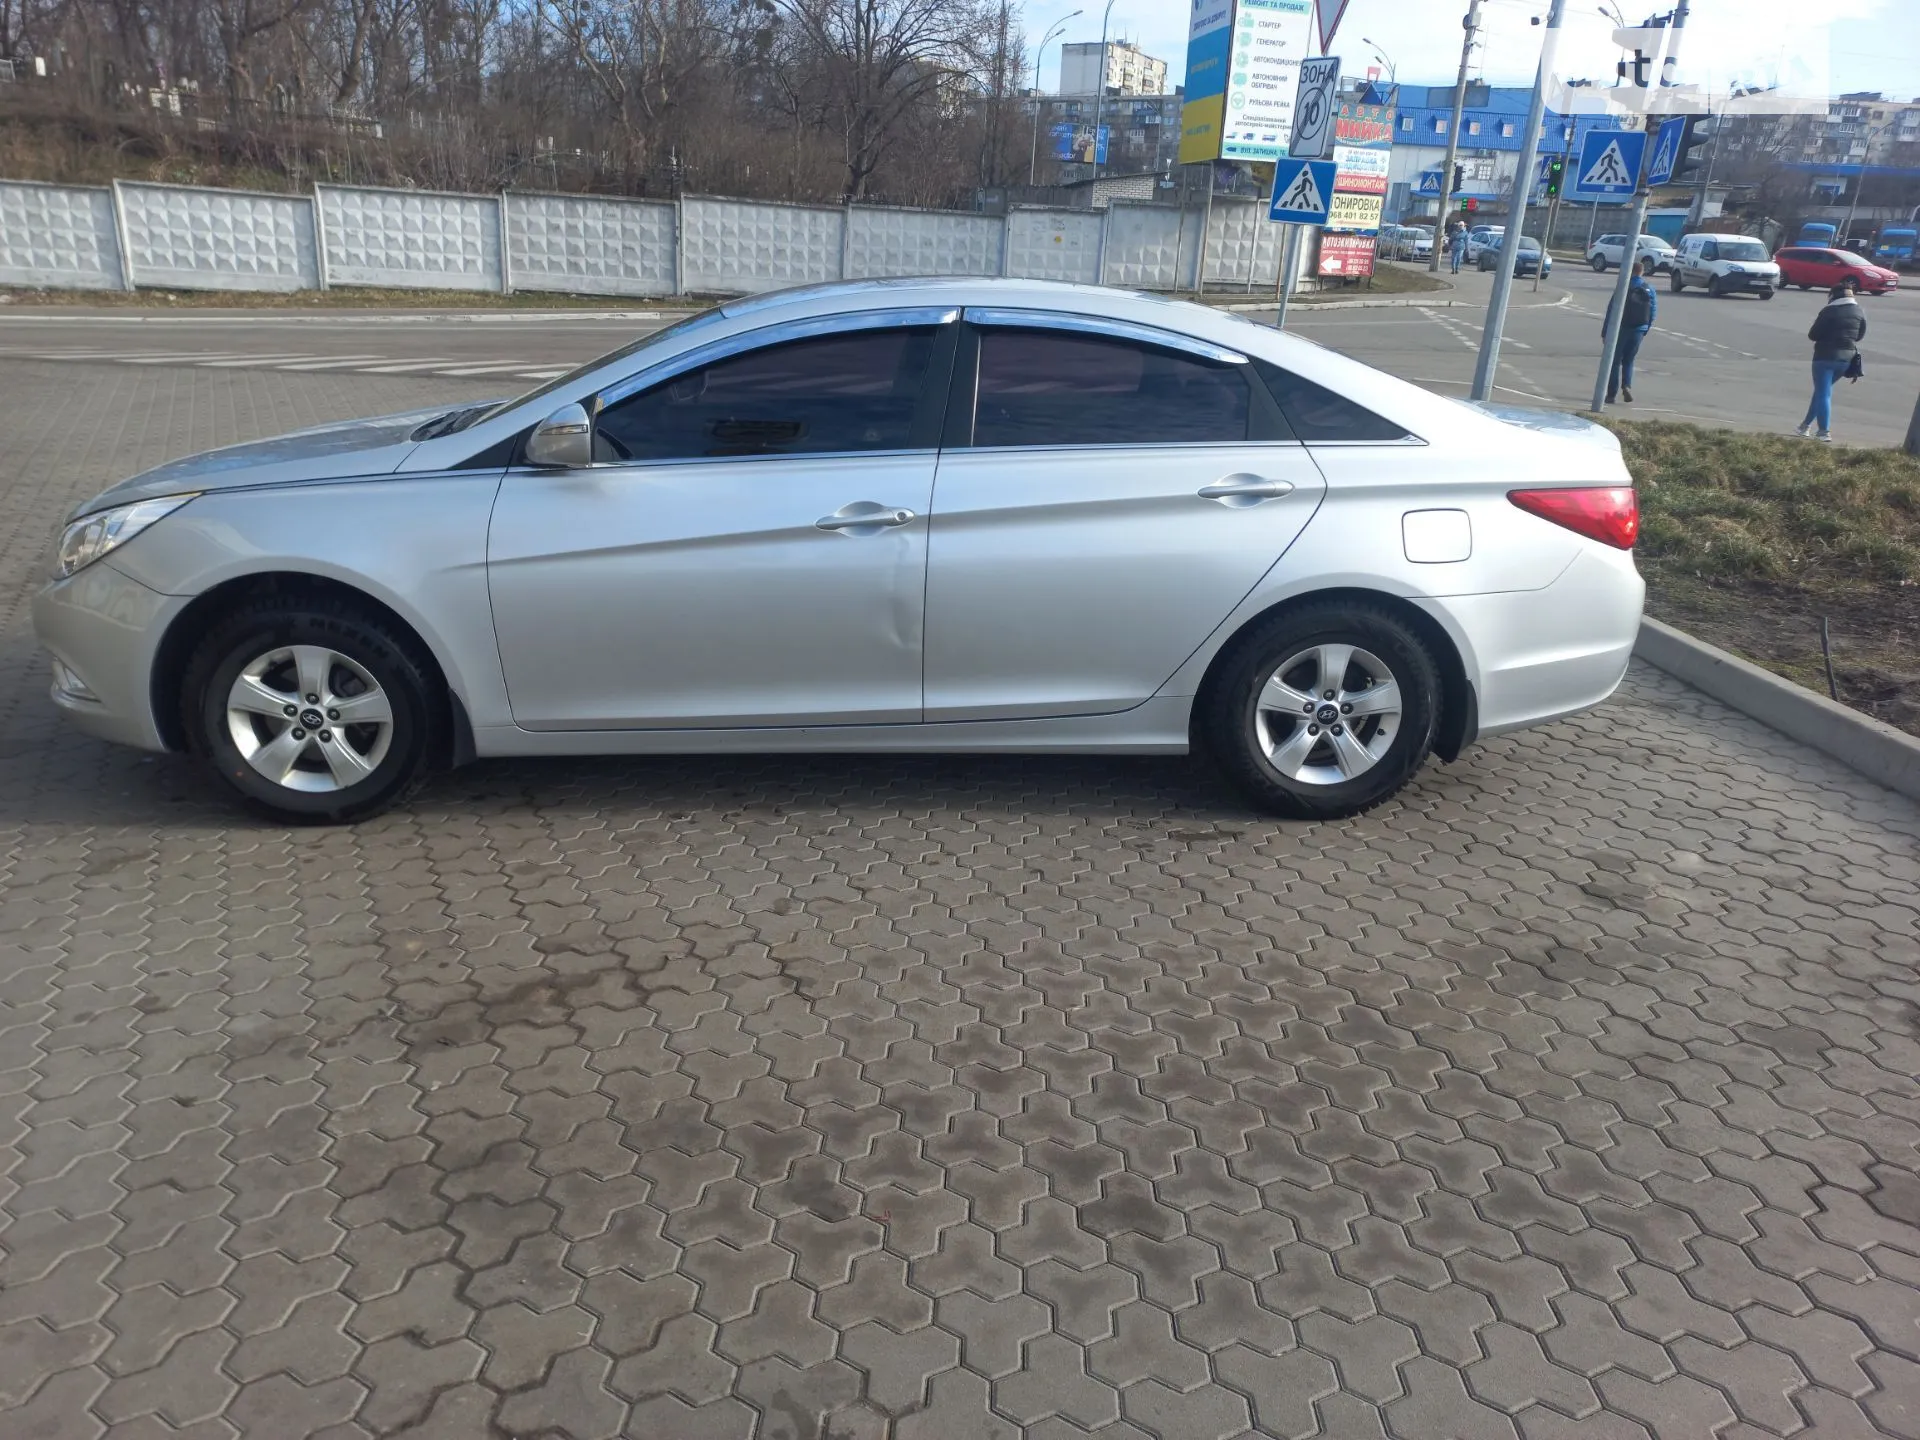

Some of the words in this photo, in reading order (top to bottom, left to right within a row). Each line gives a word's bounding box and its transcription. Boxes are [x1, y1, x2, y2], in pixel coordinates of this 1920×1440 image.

[1258, 20, 1281, 29] СТАРТЕР
[1256, 38, 1286, 48] ГЕНЕРАТОР
[1299, 63, 1335, 84] ЗОНА
[1304, 101, 1320, 126] 10
[1335, 117, 1393, 143] МИЙКА
[1370, 213, 1379, 221] 57
